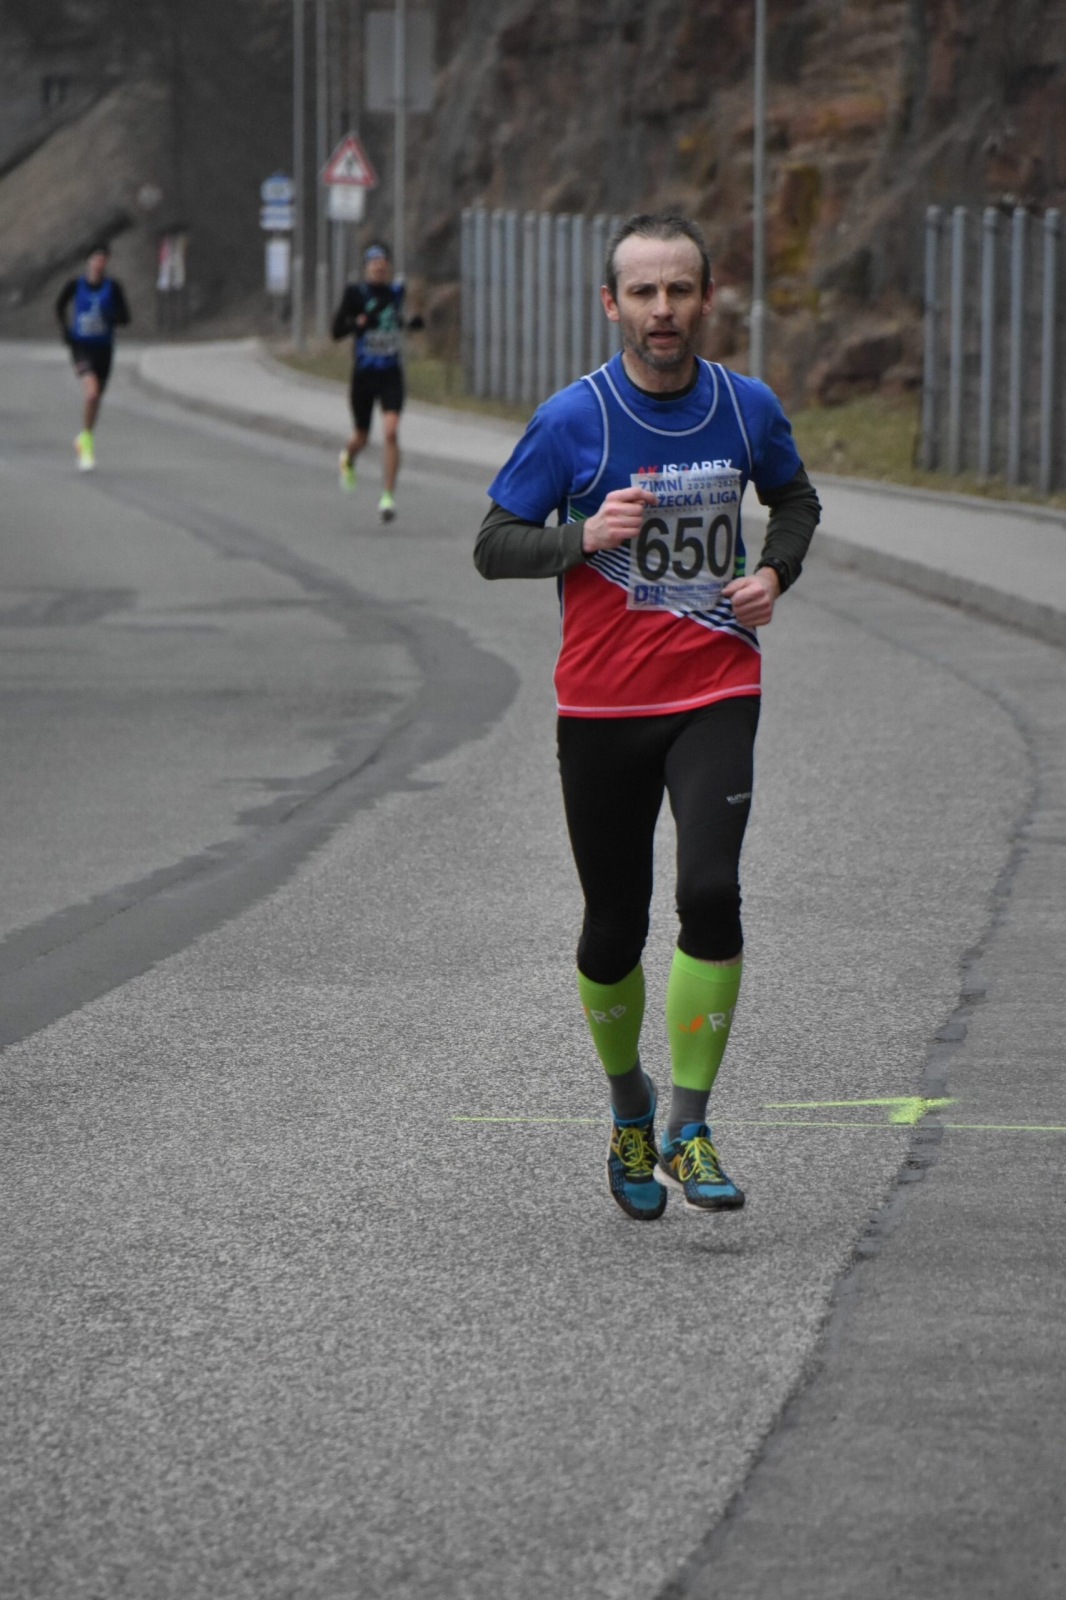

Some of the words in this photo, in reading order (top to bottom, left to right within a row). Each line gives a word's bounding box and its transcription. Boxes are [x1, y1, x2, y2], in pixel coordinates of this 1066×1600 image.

[638, 477, 683, 492] ZIMNÍ
[644, 490, 703, 508] ŽECKÁ
[709, 490, 738, 505] LIGA
[637, 514, 733, 580] 650
